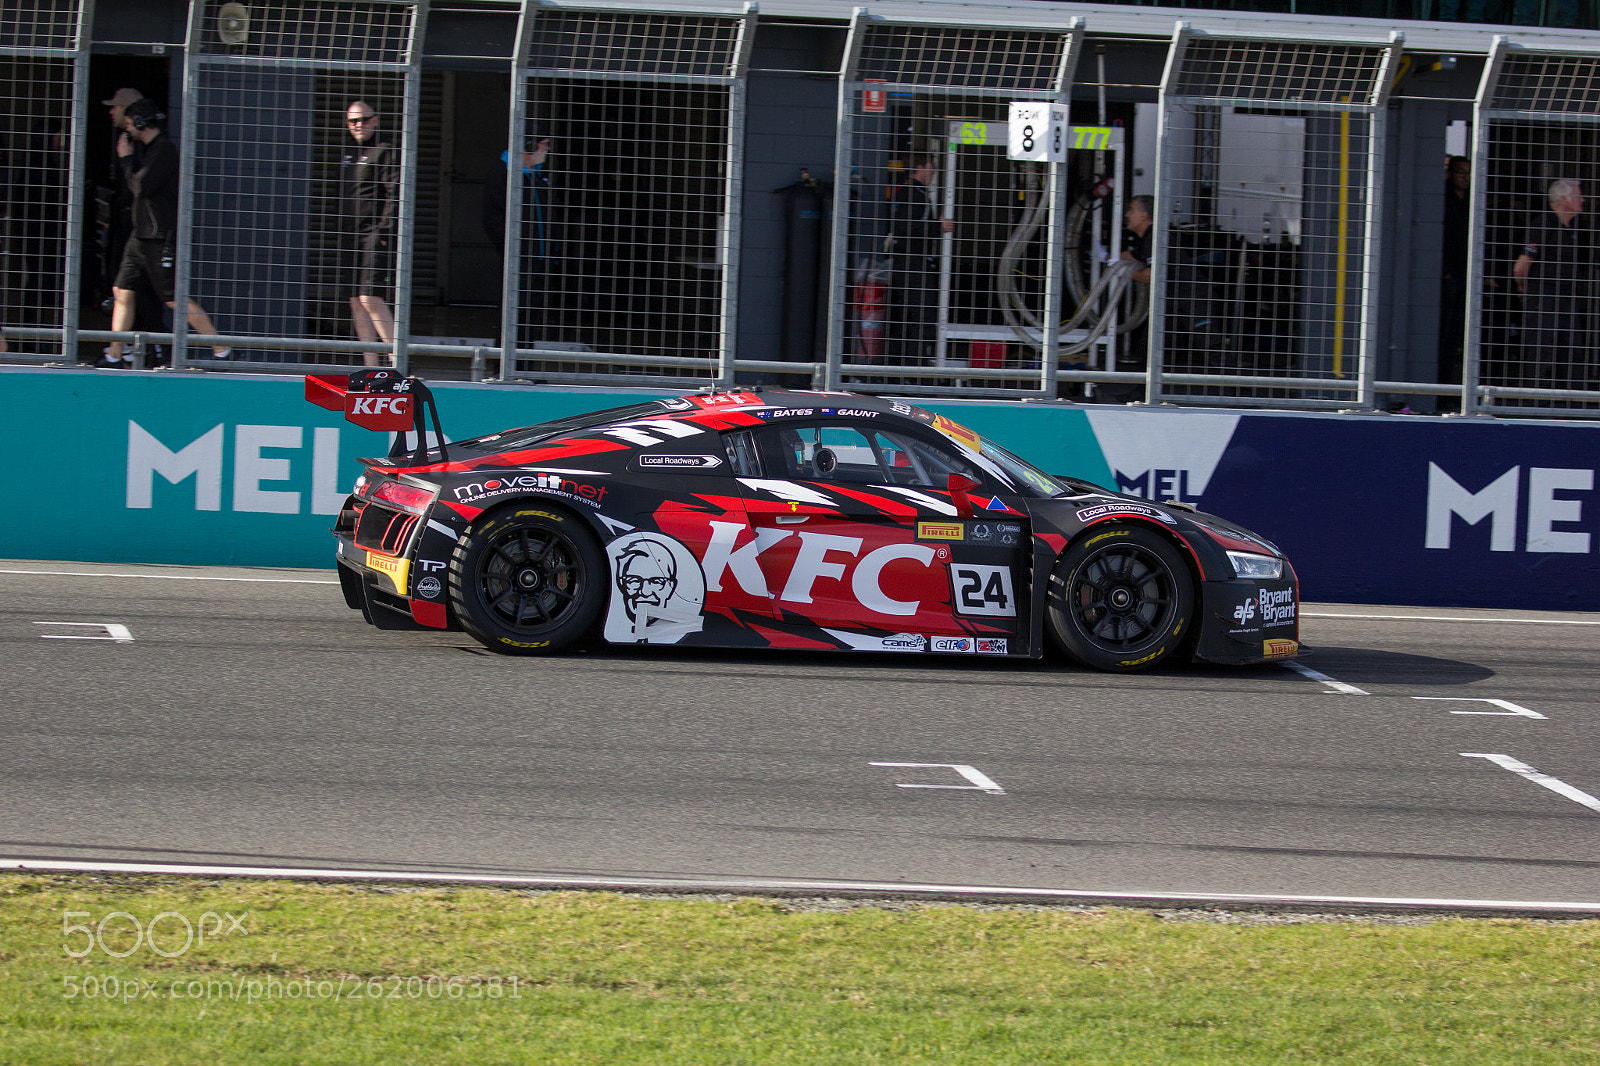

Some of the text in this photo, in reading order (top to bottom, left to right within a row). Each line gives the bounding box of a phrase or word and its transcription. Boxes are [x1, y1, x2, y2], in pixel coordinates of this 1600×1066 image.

[960, 122, 987, 145] 63
[1022, 125, 1034, 153] 8
[1073, 126, 1112, 150] 777
[351, 397, 408, 415] KFC
[773, 408, 813, 418] BATES
[837, 408, 880, 418] GAUNT
[664, 457, 700, 466] Roadways
[1116, 468, 1201, 502] MEL
[460, 487, 602, 509] ONLINE DELIVERY MANAGEMENT SYSTEM
[1083, 505, 1151, 517] Local Roadways
[921, 525, 960, 537] PIRELLI
[369, 553, 399, 572] PIRELLI
[419, 559, 447, 572] TP
[702, 520, 936, 617] KFC
[957, 569, 1008, 610] 24
[1259, 587, 1293, 607] Bryant
[1233, 598, 1255, 625] afs
[1263, 602, 1296, 622] Bryant
[1268, 641, 1295, 654] PIRELLI
